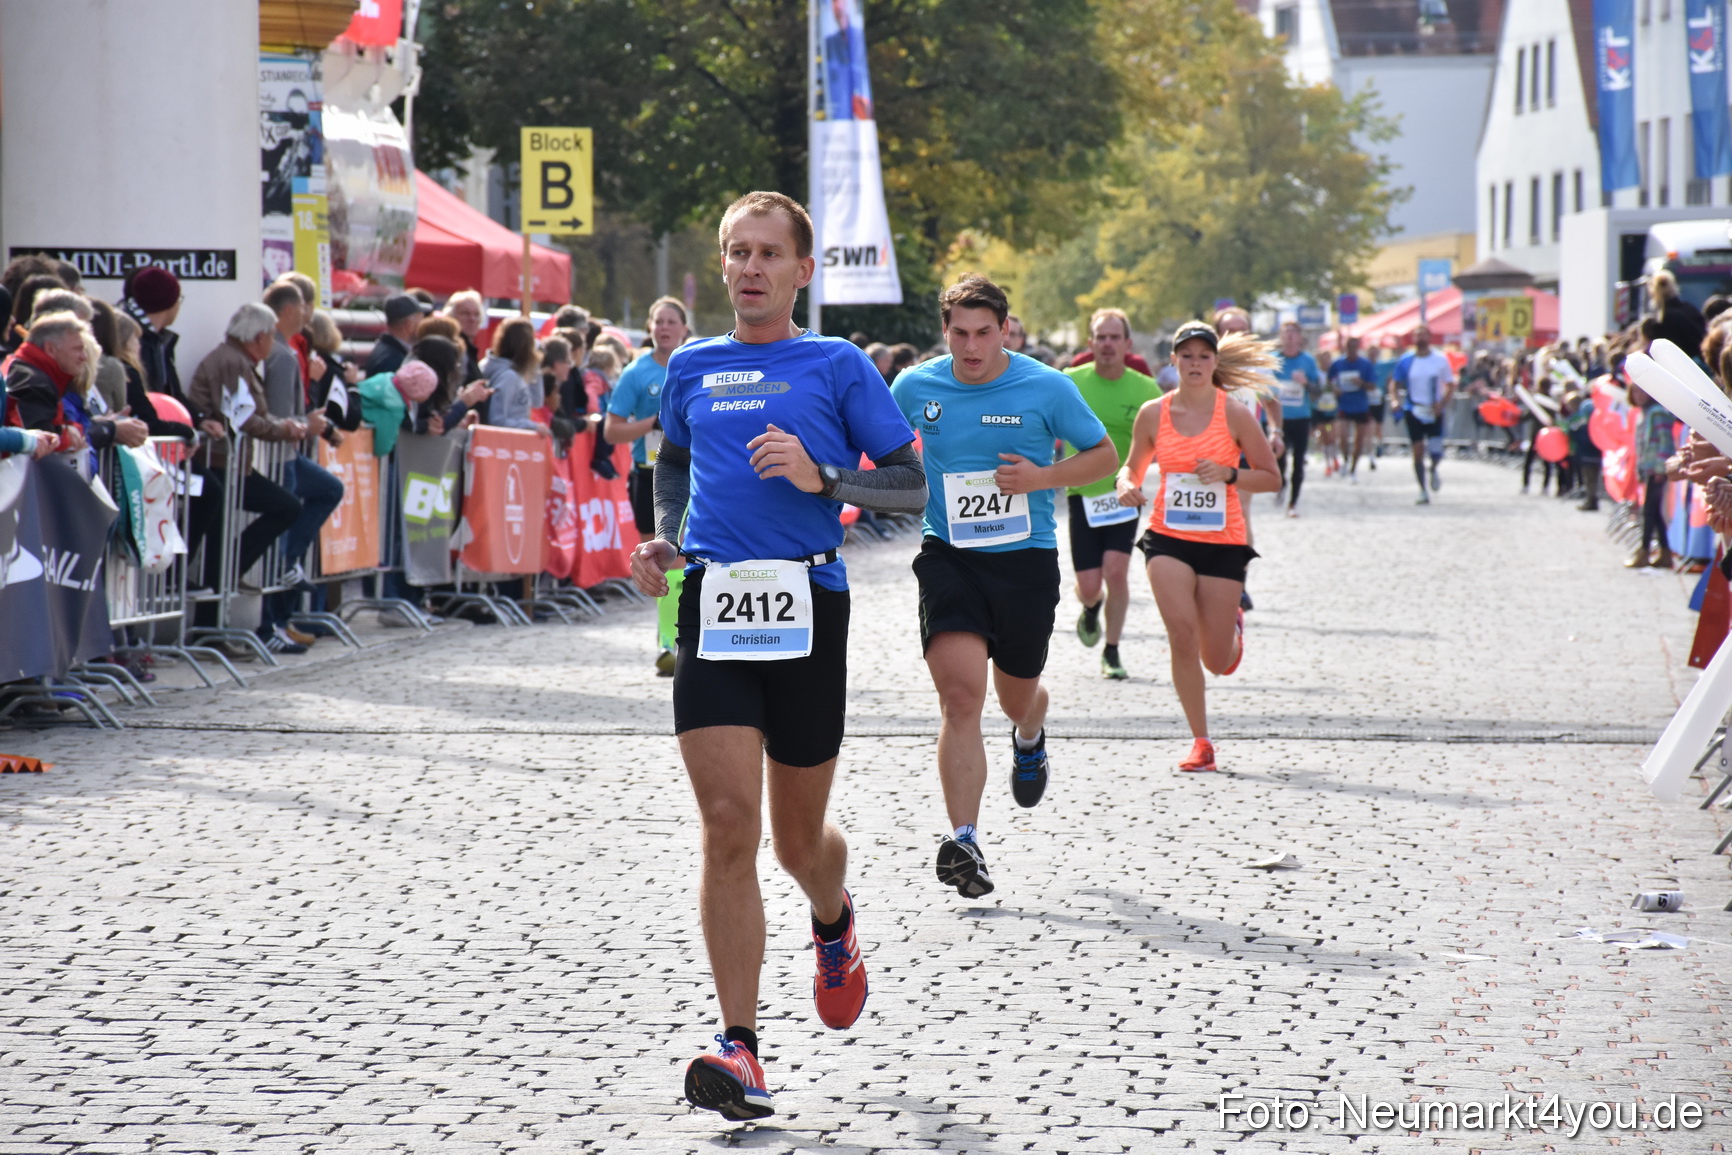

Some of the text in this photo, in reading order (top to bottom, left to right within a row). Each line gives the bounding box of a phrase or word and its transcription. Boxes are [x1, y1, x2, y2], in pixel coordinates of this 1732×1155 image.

[530, 132, 583, 152] Block
[541, 161, 574, 210] B
[716, 372, 754, 384] HEUTE
[725, 383, 781, 395] MORGEN
[711, 399, 766, 412] BEWEGEN
[981, 415, 1022, 425] BOCK
[957, 493, 1014, 518] 2247
[1092, 497, 1121, 513] 258
[1173, 490, 1217, 508] 2159
[974, 523, 1005, 533] Markus
[740, 570, 778, 578] BOCK
[716, 592, 795, 623] 2412
[731, 635, 781, 645] Christian
